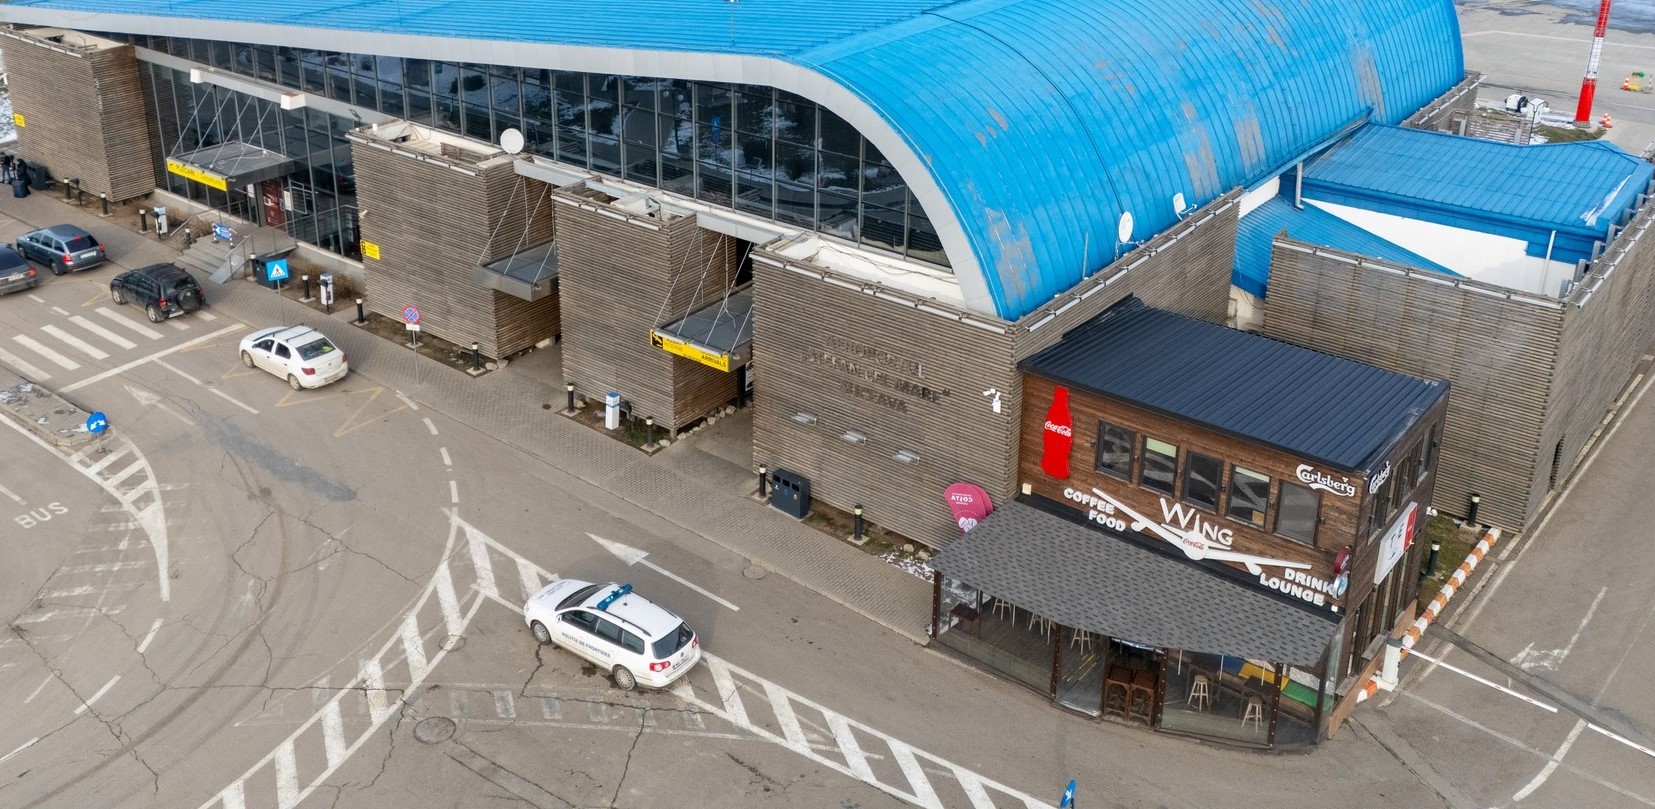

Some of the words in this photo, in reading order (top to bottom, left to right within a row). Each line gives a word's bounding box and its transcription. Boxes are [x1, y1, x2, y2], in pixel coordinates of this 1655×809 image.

[701, 354, 727, 368] ARRIVALS
[1296, 463, 1356, 498] Carlsberg
[13, 502, 69, 529] BUS
[1063, 487, 1116, 516] COFFEE
[1088, 509, 1127, 532] FOOD
[1259, 572, 1325, 607] LOUNGE
